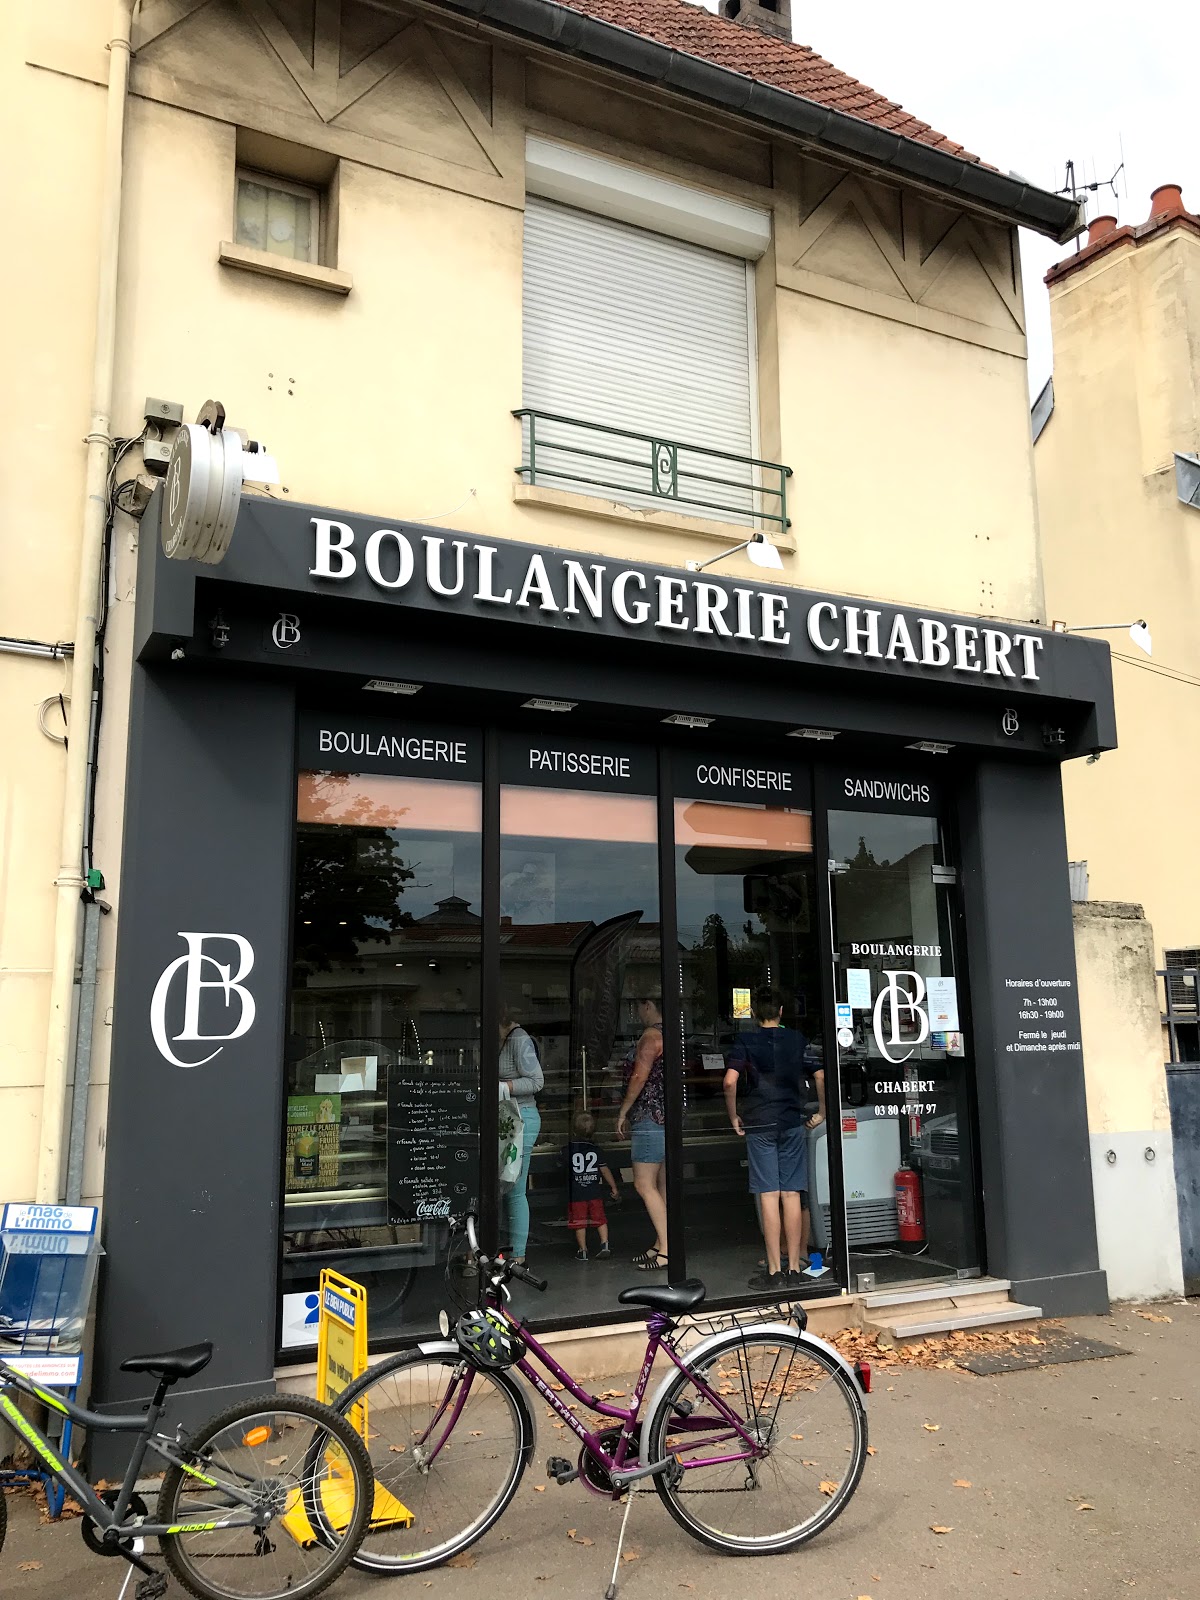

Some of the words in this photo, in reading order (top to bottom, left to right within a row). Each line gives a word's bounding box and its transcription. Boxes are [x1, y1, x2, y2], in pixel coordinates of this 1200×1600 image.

[309, 517, 790, 645] BOULANGERIE
[806, 601, 1044, 681] CHABERT
[319, 729, 467, 764] BOULANGERIE
[529, 749, 630, 778] PATISSERIE
[696, 764, 792, 791] CONFISERIE
[844, 778, 930, 803] SANDWICHS
[851, 943, 942, 957] BOULANGERIE
[1005, 978, 1033, 987] Horaires
[1034, 978, 1071, 988] d'ouverture
[1023, 998, 1032, 1007] 7h
[1037, 997, 1058, 1007] 13h00
[1018, 1010, 1039, 1019] 16h30
[1044, 1010, 1065, 1019] 19h00
[1018, 1030, 1040, 1039] Fermé
[1041, 1030, 1047, 1039] le
[1051, 1029, 1067, 1040] jeudi
[1006, 1043, 1013, 1052] et
[1014, 1042, 1047, 1052] Dimanche
[1048, 1041, 1067, 1052] après
[1067, 1041, 1081, 1050] midi
[874, 1080, 936, 1093] CHABERT
[874, 1105, 885, 1116] 03
[887, 1105, 898, 1116] 80
[900, 1105, 911, 1115] 47
[912, 1104, 924, 1115] 77
[926, 1103, 937, 1114] 97
[572, 1151, 598, 1174] 92
[325, 1289, 331, 1306] LE
[340, 1299, 355, 1321] PUBLIC
